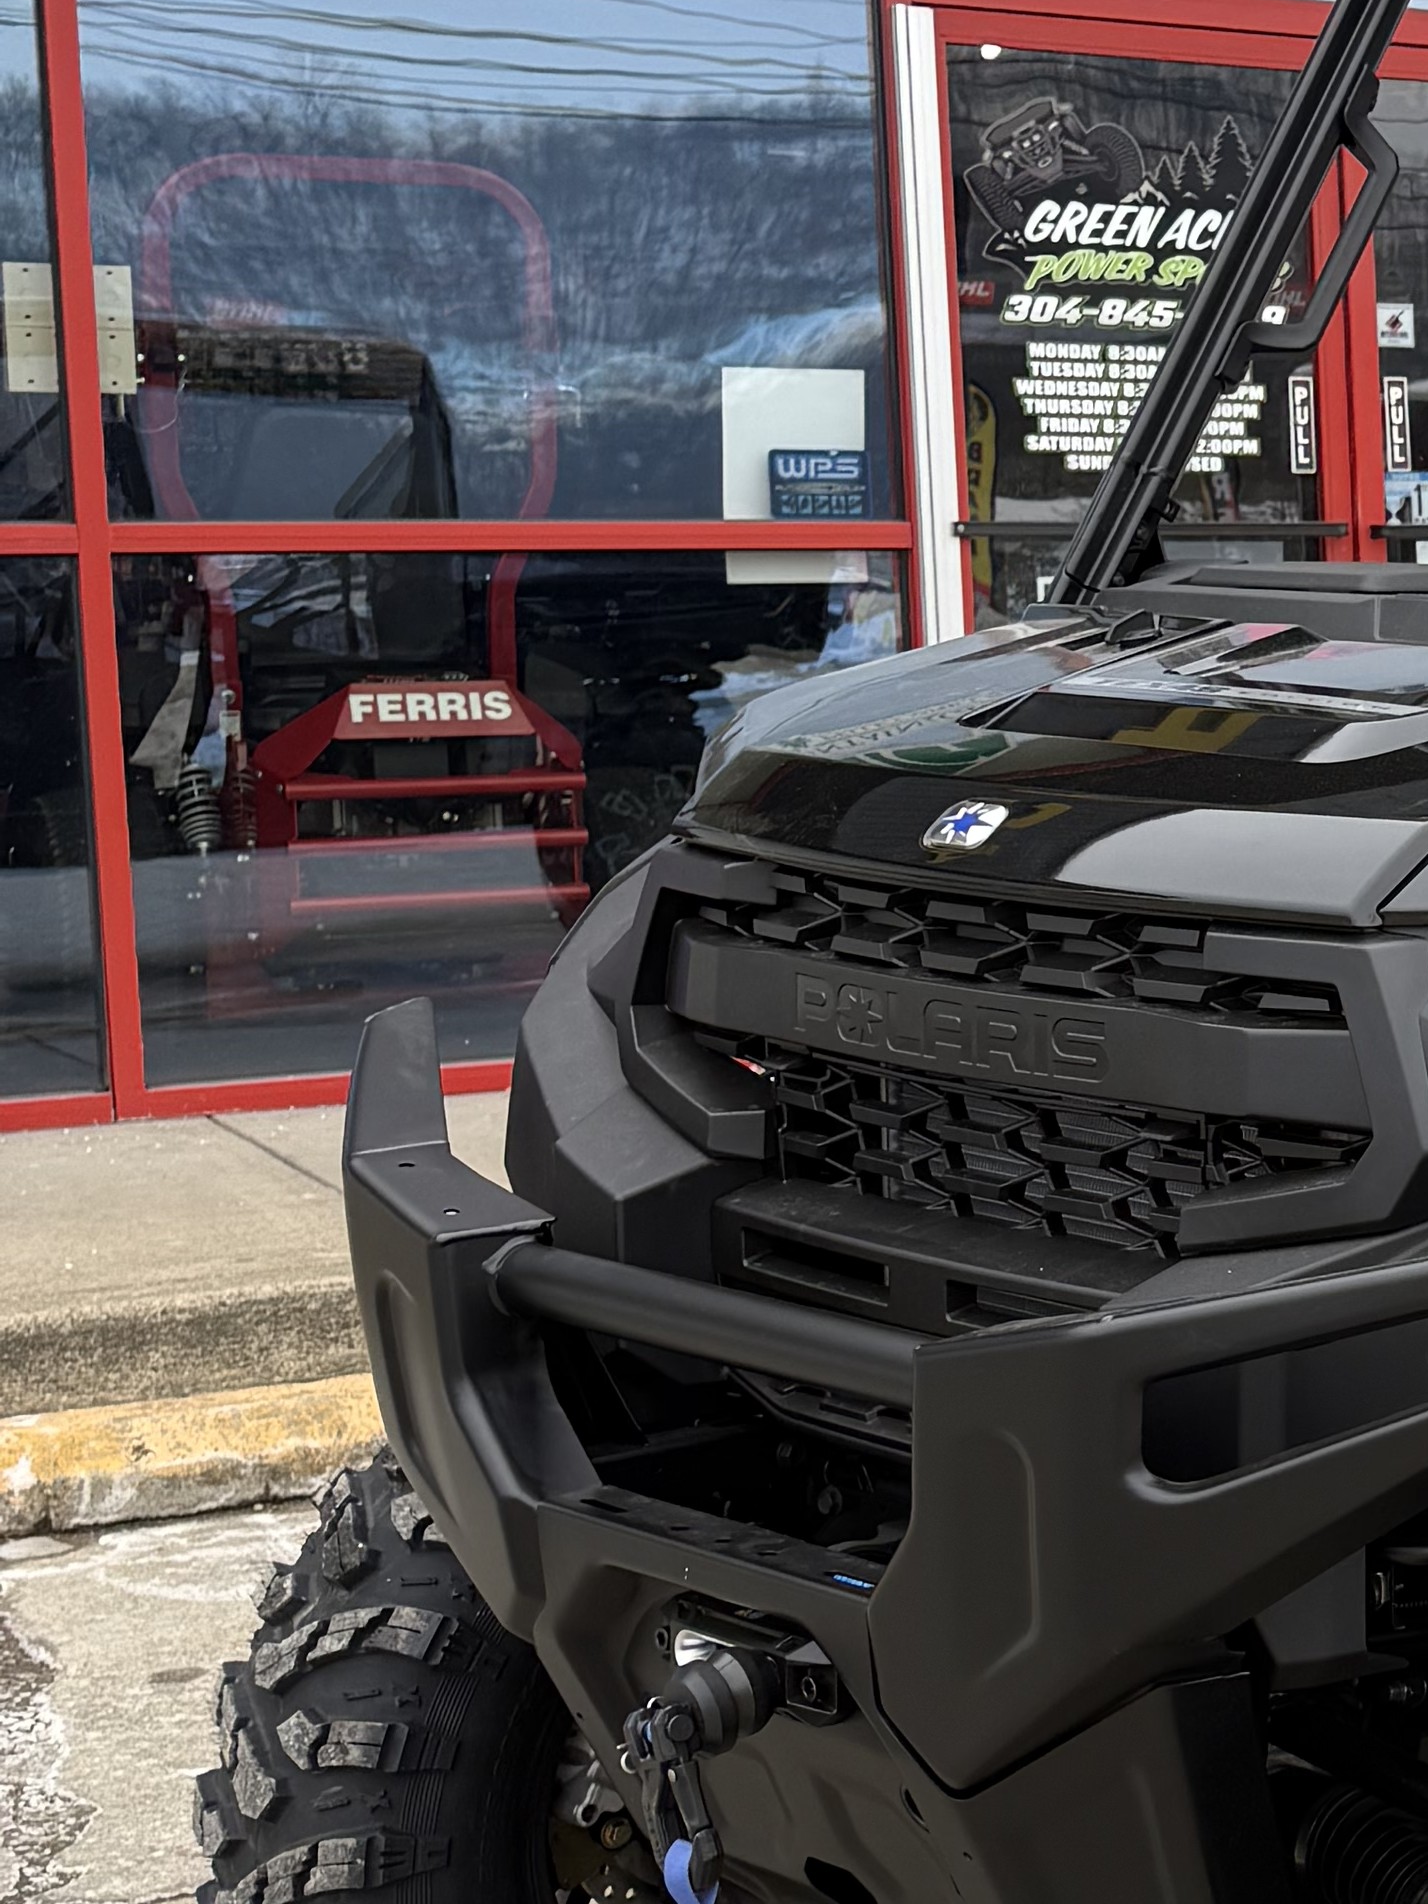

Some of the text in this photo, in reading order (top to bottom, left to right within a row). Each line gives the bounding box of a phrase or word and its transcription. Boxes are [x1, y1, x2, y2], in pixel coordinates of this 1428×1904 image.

[1023, 199, 1167, 248] GREEN
[1024, 249, 1154, 291] POWER
[1028, 342, 1101, 360] MONDAY
[1030, 361, 1105, 379] TUESDAY
[1016, 380, 1120, 398] WEDNESDAY
[1024, 399, 1114, 416] THURSDAY
[1040, 417, 1100, 434] FRIDAY
[1294, 386, 1310, 465] PULL
[1389, 386, 1406, 464] PULL
[1026, 436, 1114, 453] SATURDAY
[776, 457, 860, 480] WPS
[349, 689, 513, 725] FERRIS
[795, 972, 1109, 1084] POLARIS
